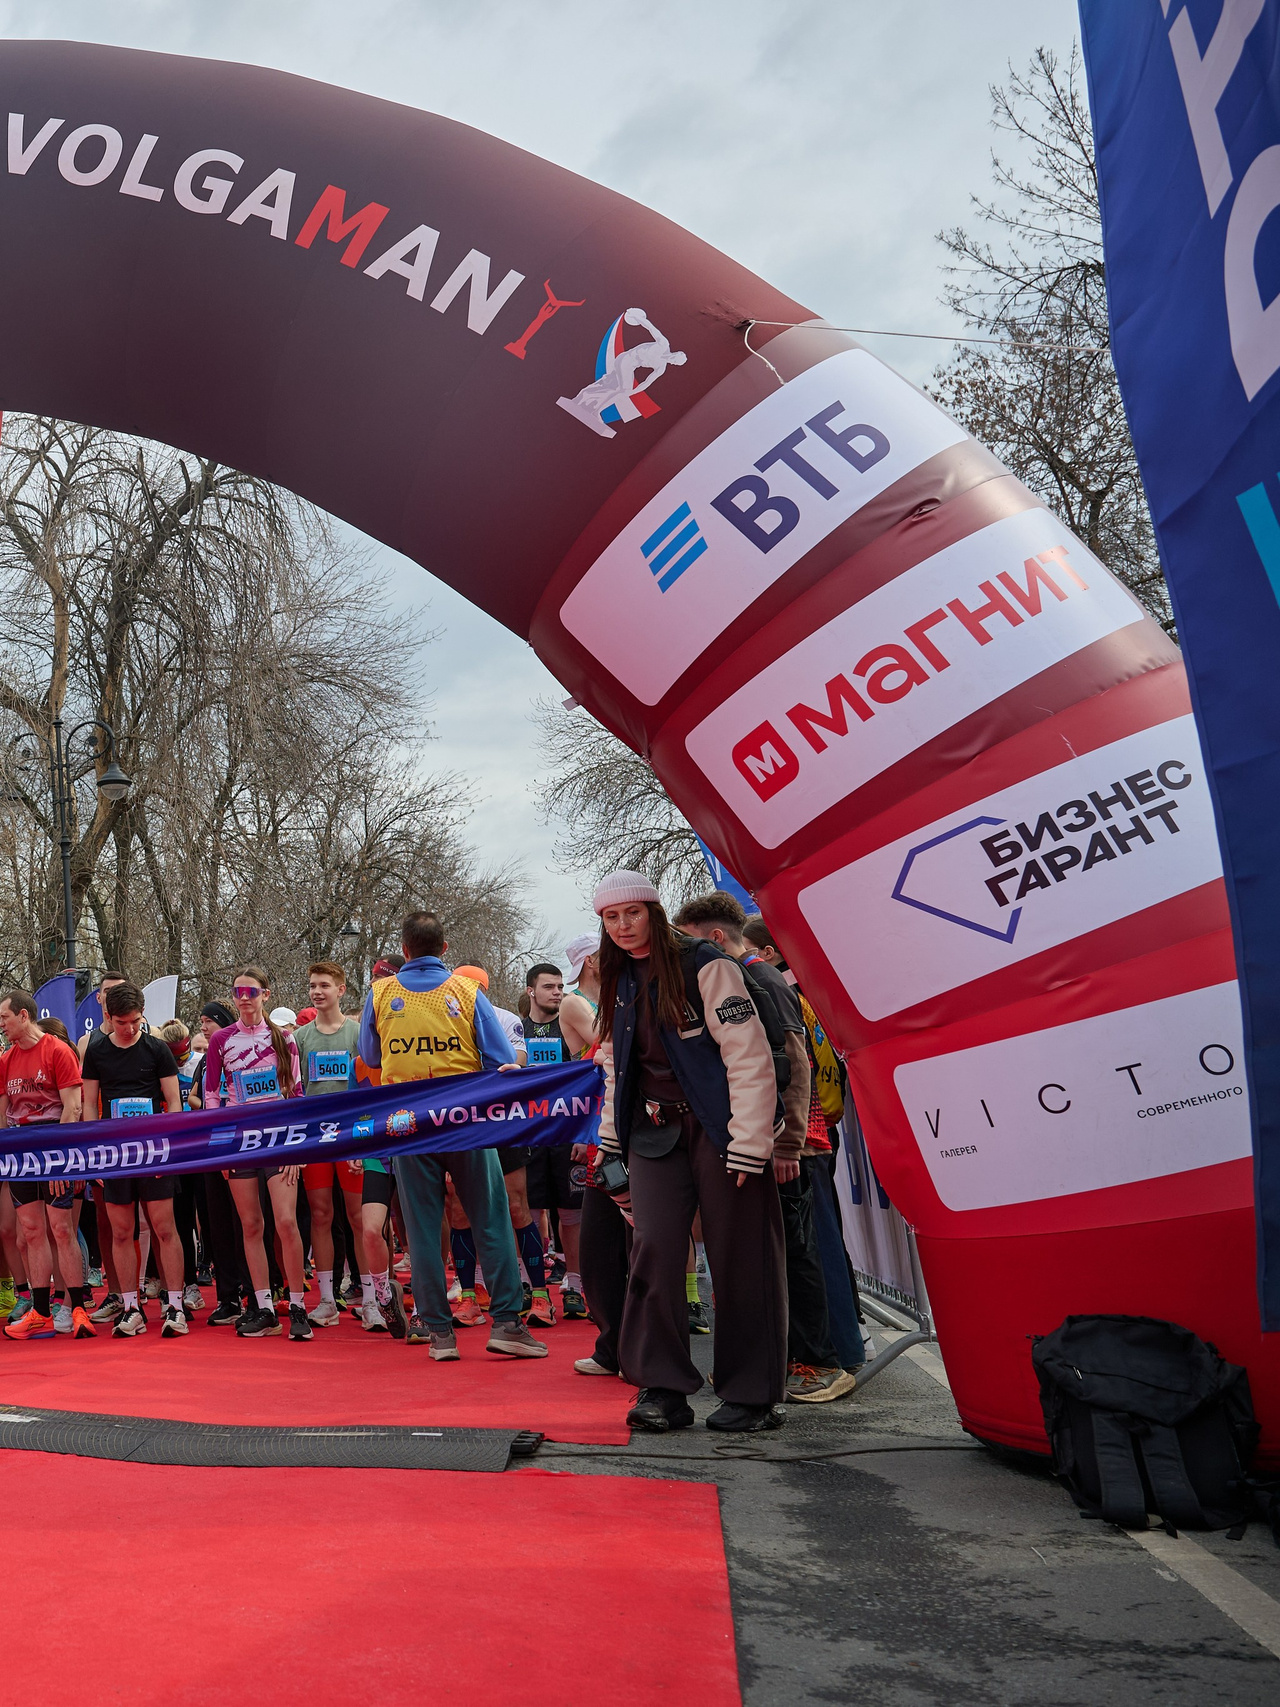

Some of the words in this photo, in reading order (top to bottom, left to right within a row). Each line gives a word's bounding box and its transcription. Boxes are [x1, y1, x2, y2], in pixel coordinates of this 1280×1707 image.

[6, 111, 527, 336] VOLGAMAN
[709, 400, 891, 554] ВТБ
[979, 759, 1193, 868] БИЗНЕС
[984, 799, 1180, 907] ГАРАНТ
[718, 1003, 753, 1019] YOURSELF
[388, 1036, 462, 1055] СУДЬЯ
[533, 1050, 557, 1061] 5115
[318, 1063, 347, 1075] 5400
[245, 1079, 276, 1095] 5049
[428, 1096, 591, 1127] VOLGAMAN
[1136, 1086, 1244, 1119] СОВРЕМЕННОГО
[238, 1123, 308, 1152] ВТБ
[939, 1144, 978, 1159] ГАЛЕРЕЯ
